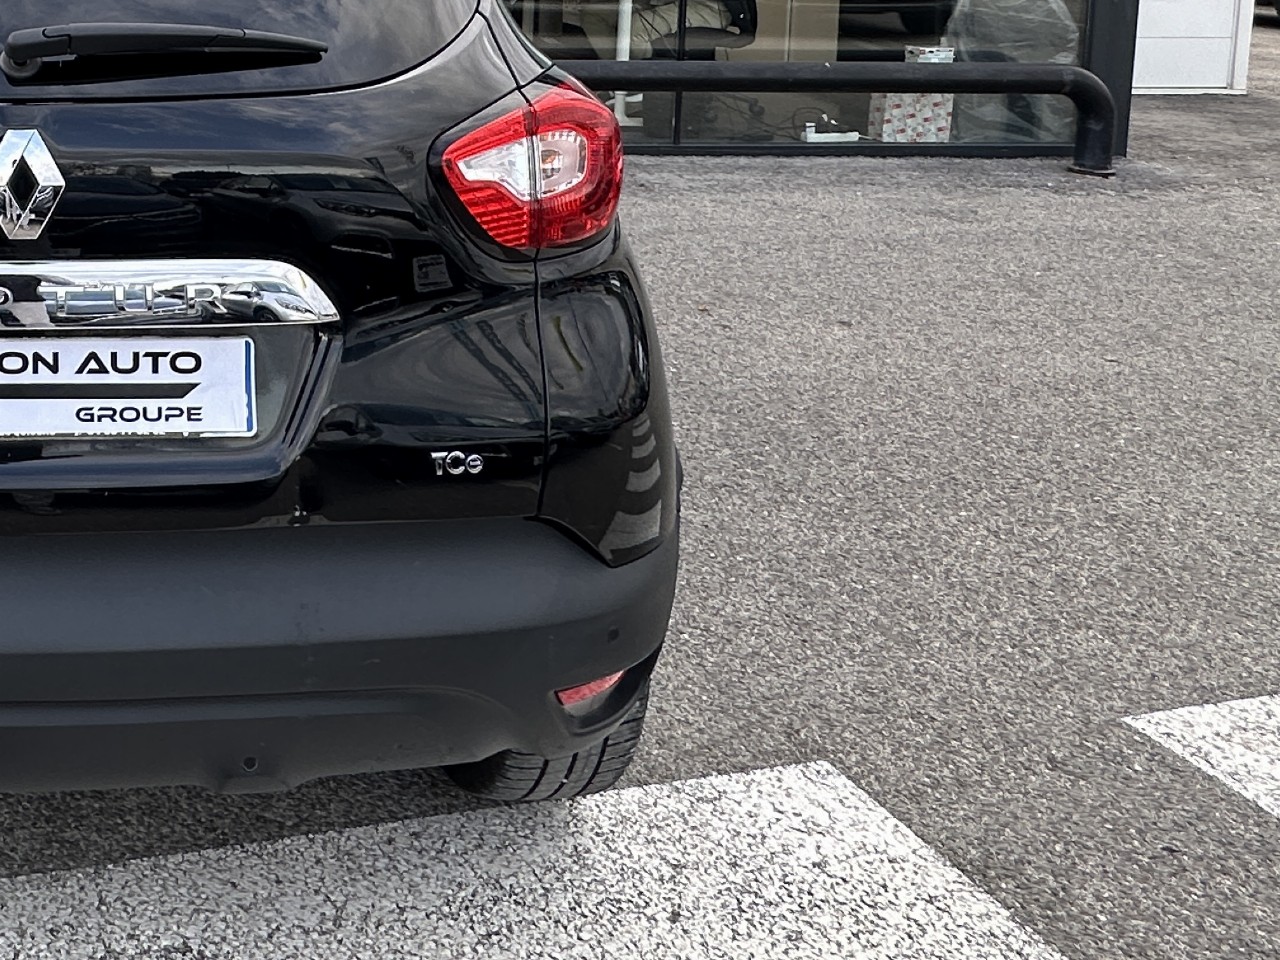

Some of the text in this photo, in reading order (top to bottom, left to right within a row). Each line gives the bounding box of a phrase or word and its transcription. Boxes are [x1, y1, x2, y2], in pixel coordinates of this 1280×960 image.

[74, 351, 203, 375] AUTO
[75, 406, 204, 423] GROUPE
[430, 450, 484, 476] TCe
